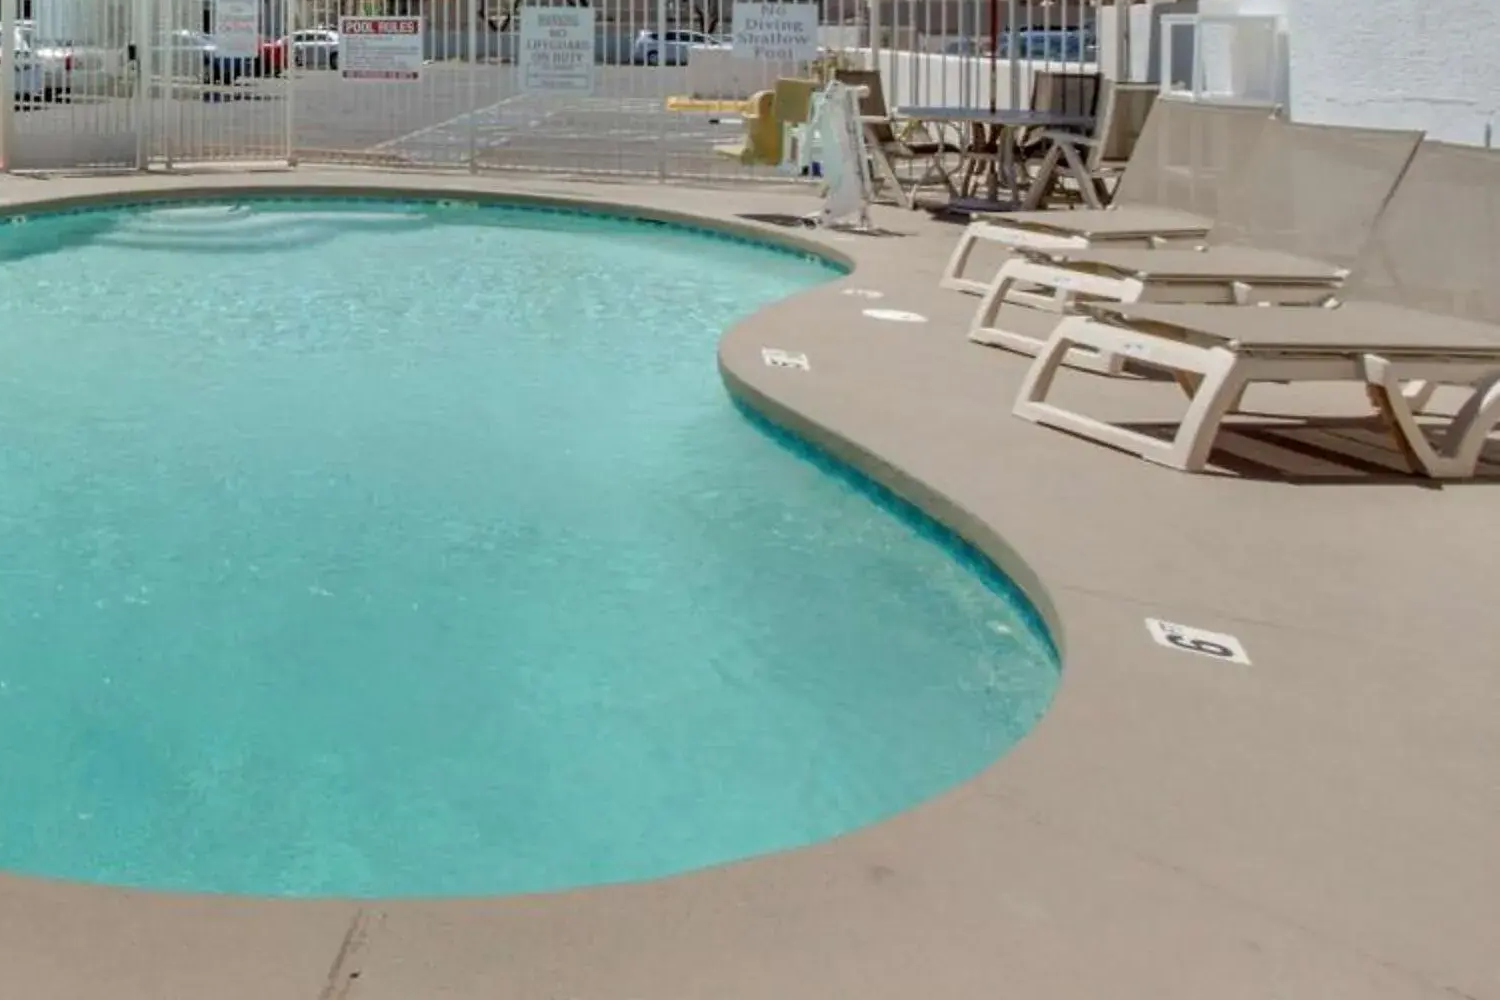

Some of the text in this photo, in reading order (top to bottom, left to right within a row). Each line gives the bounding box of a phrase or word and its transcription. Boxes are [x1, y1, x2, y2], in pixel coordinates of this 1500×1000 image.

[762, 3, 787, 16] No
[345, 21, 373, 33] POOL
[378, 21, 414, 33] RULES
[745, 18, 804, 33] Diving
[737, 32, 810, 45] Shallow
[754, 46, 794, 59] Pool
